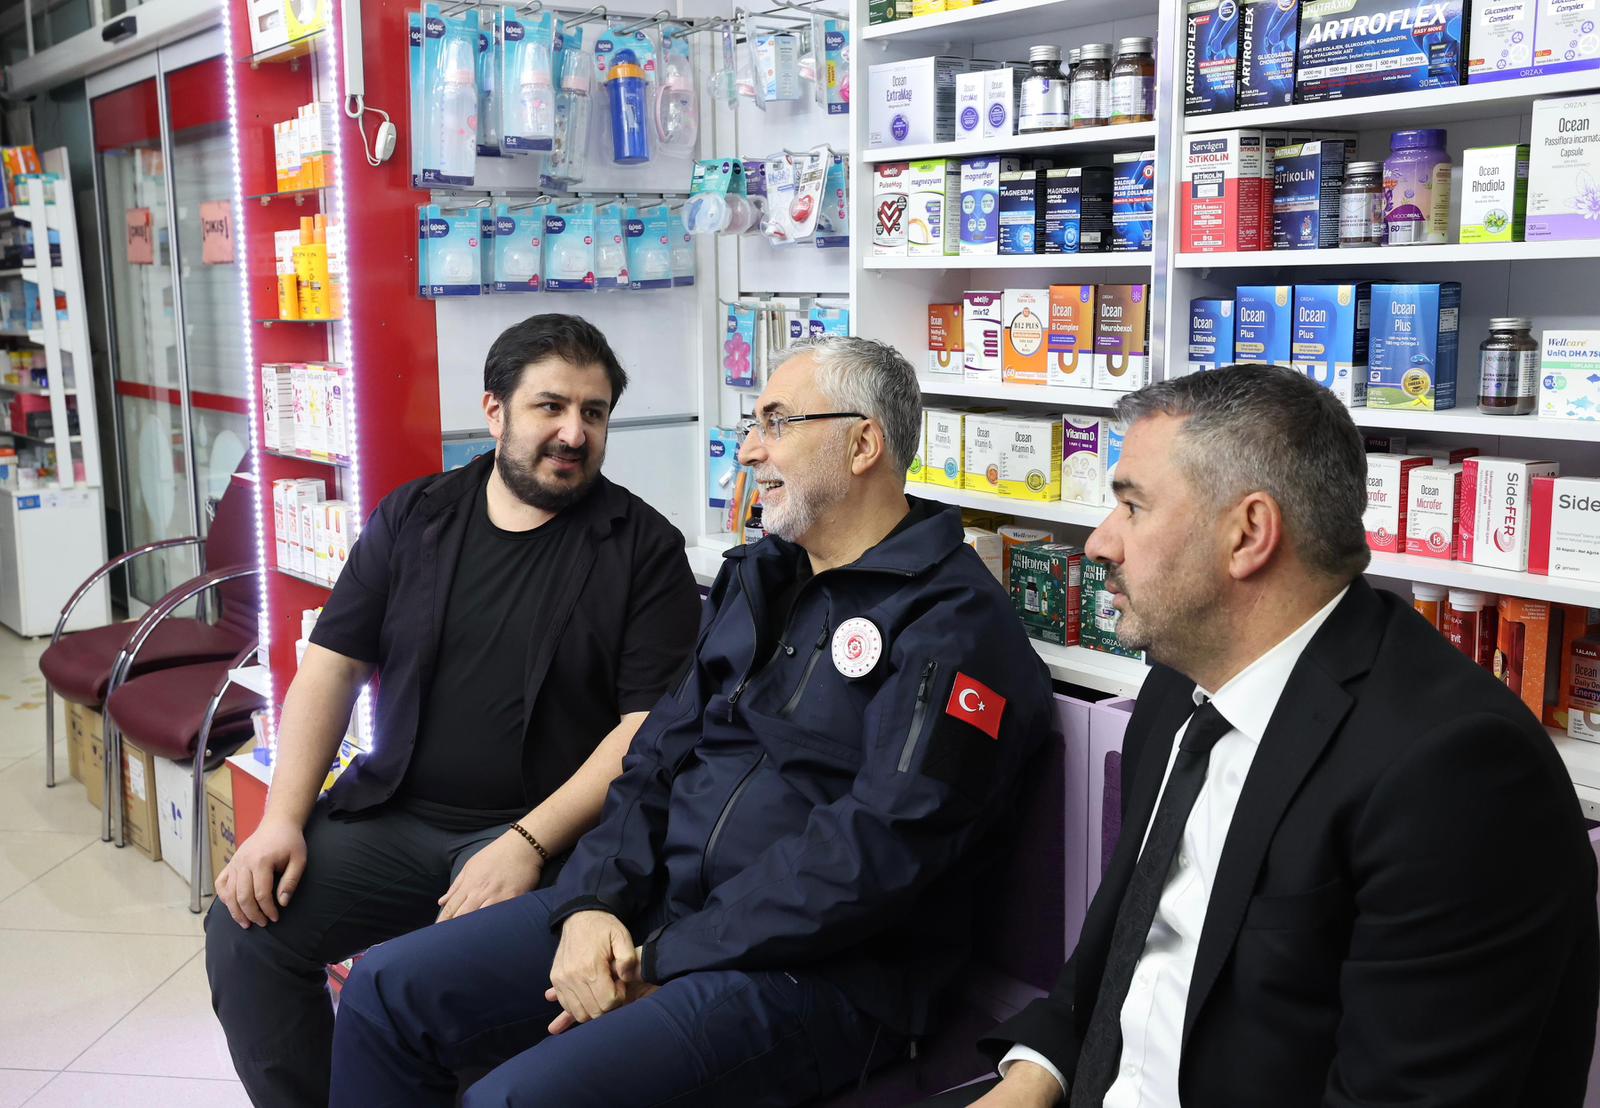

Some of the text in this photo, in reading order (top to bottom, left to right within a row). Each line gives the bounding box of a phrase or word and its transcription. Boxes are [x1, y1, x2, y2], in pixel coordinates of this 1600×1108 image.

[1484, 4, 1523, 15] Glucosamine
[1556, 3, 1584, 13] Complex
[1305, 2, 1450, 45] ARTROFLEX
[1488, 14, 1514, 23] Complex
[1241, 8, 1254, 86] ARTROFLEX
[1186, 17, 1197, 94] ARTROFLEX
[1520, 68, 1543, 77] ORZAX
[893, 75, 908, 88] Ocean
[1418, 80, 1428, 88] 30
[887, 89, 913, 103] ExtraMag
[1558, 117, 1589, 133] Ocean
[1544, 136, 1572, 146] Passiflora
[1560, 147, 1583, 158] Capsule
[1275, 169, 1315, 184] SİTİKOLİN
[1479, 165, 1499, 177] Ocean
[1047, 187, 1080, 195] MAGNESIUM
[1472, 179, 1505, 192] Rhodiola
[1001, 189, 1034, 198] MAGNESIUM
[973, 308, 990, 316] mix12
[1052, 303, 1072, 317] Ocean
[1101, 303, 1122, 317] Ocean
[1391, 300, 1416, 315] Ocean
[1241, 306, 1265, 322] Ocean
[1299, 306, 1326, 323] Ocean
[1056, 323, 1079, 332] Complex
[1101, 323, 1133, 333] Neurobexol
[1193, 316, 1213, 329] Ocean
[1394, 319, 1411, 332] Plus
[1193, 333, 1217, 343] Ultimate
[1240, 329, 1255, 338] Plus
[1298, 329, 1314, 339] Plus
[1548, 338, 1586, 347] Wellcare
[1547, 350, 1567, 358] UniQ
[976, 427, 990, 438] Ocean
[1015, 431, 1032, 443] Ocean
[1065, 428, 1090, 441] Vitamin
[1011, 443, 1030, 453] Vitamin
[1367, 476, 1383, 488] cean
[1421, 484, 1440, 496] Ocean
[1416, 497, 1443, 511] Microfer
[1503, 472, 1518, 536] SideFER
[1575, 663, 1598, 678] Ocean
